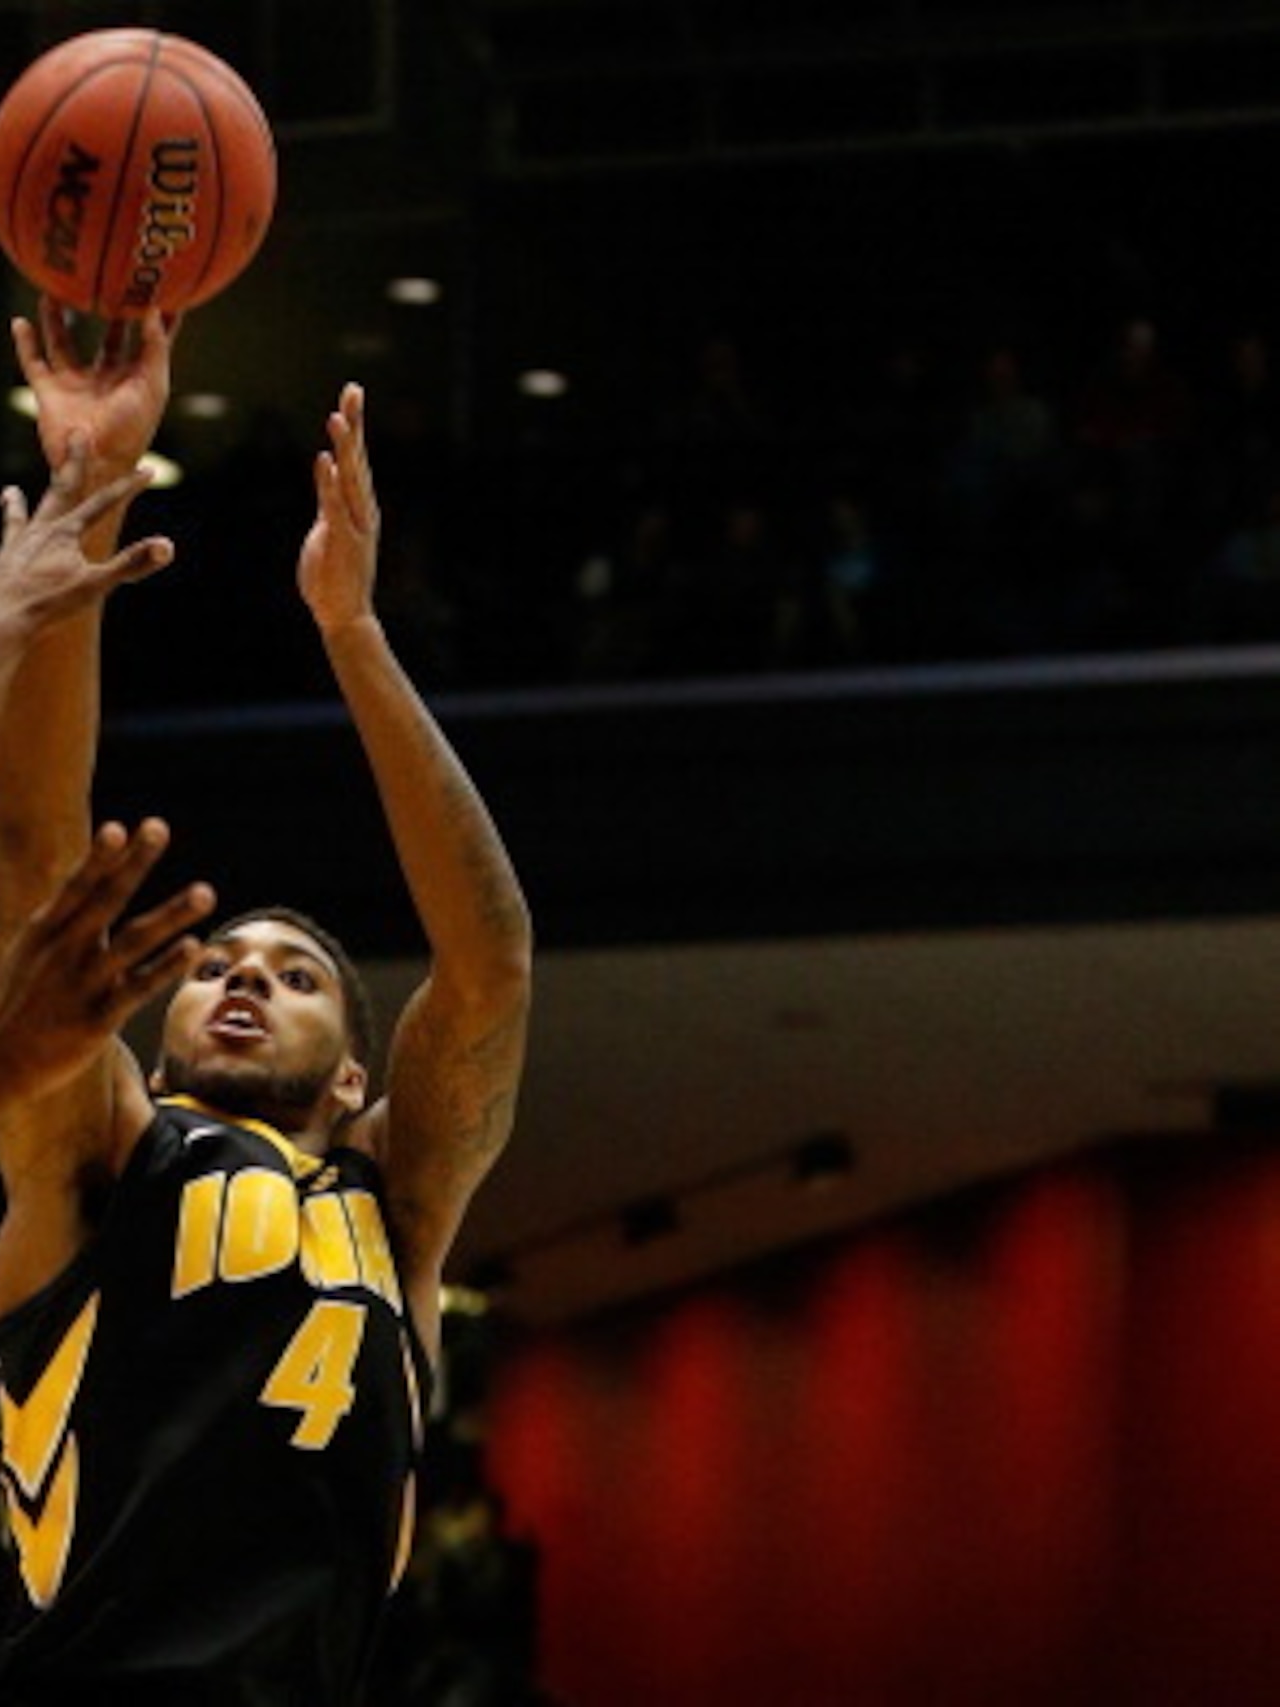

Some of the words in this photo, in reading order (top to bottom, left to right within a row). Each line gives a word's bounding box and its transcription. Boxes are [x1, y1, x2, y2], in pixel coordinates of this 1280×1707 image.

[42, 141, 102, 276] NCAA
[119, 135, 201, 307] Wilson
[257, 1299, 367, 1450] 4
